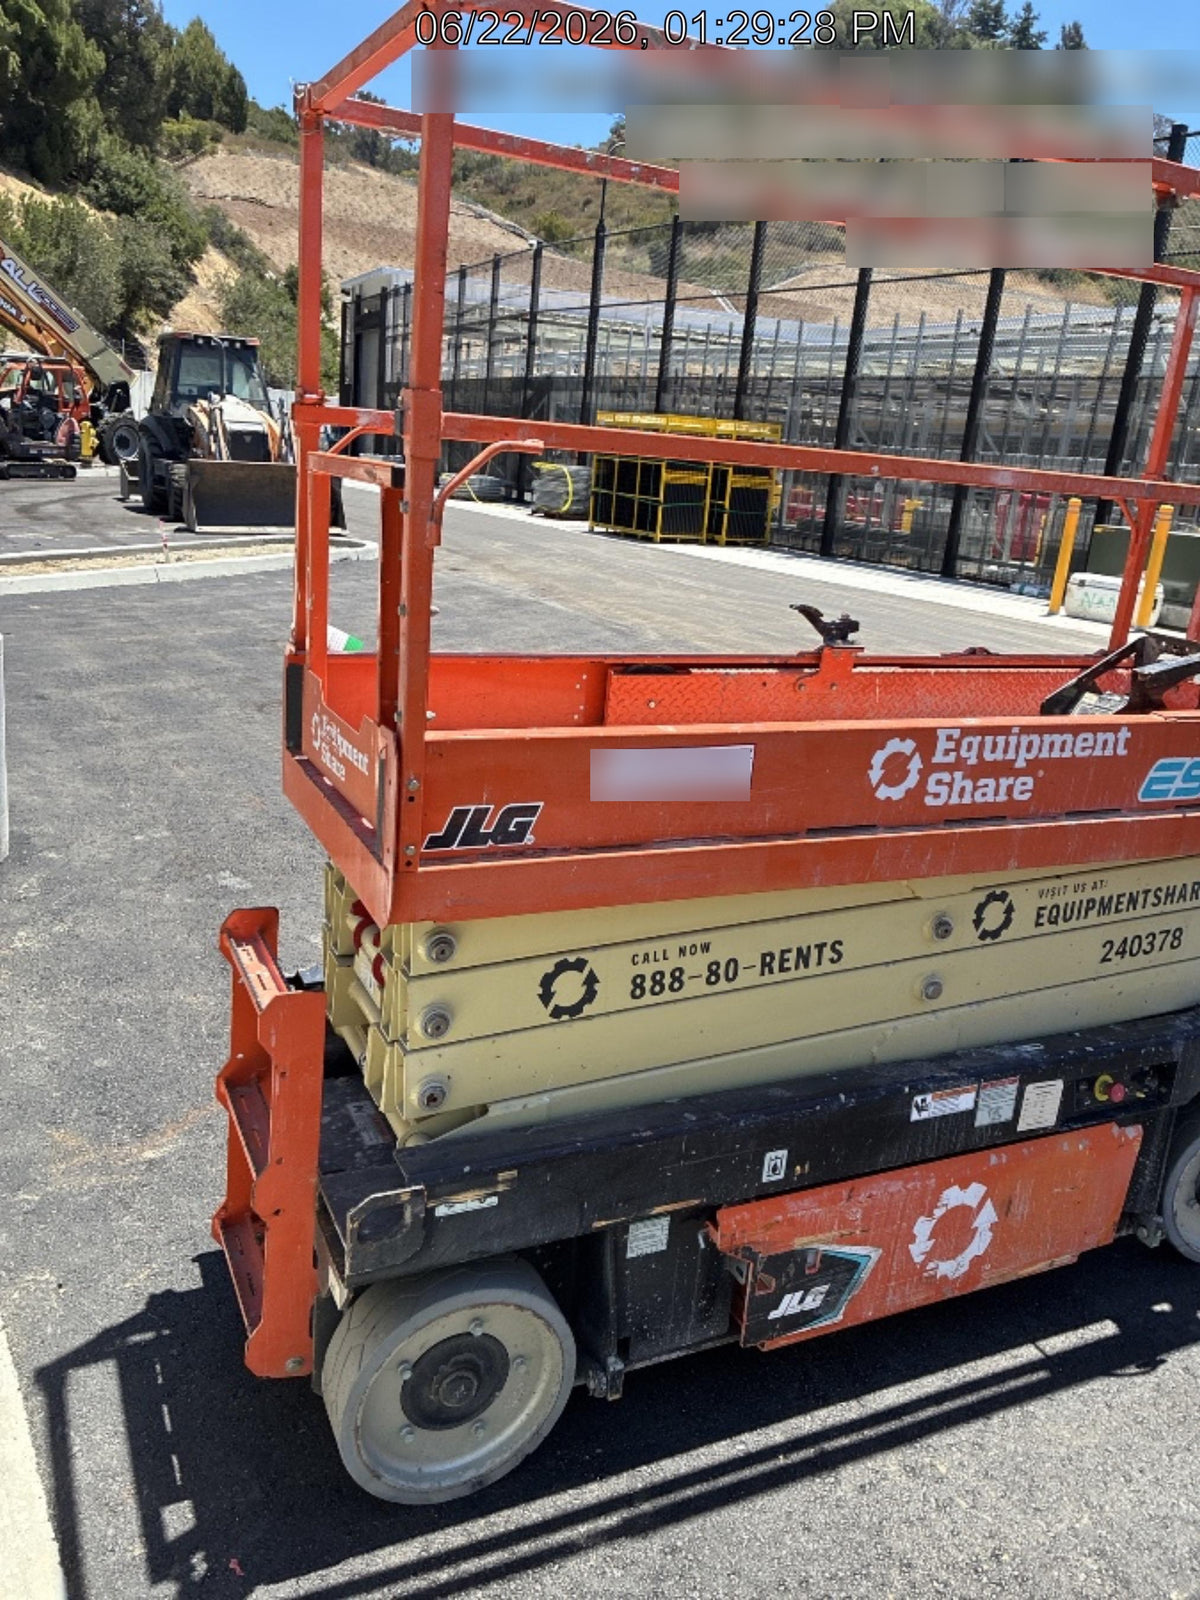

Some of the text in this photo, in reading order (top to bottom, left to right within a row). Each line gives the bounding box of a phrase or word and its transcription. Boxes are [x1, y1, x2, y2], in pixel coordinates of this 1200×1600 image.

[931, 726, 1131, 768] Equipment
[924, 770, 1034, 806] Share
[421, 801, 544, 851] JLG
[1038, 884, 1069, 899] VISIT
[1073, 882, 1088, 894] US
[631, 941, 712, 966] CALL NOW
[1100, 927, 1184, 963] 240378
[630, 940, 845, 1000] 888-80-RENTS
[767, 1283, 831, 1320] JLG
